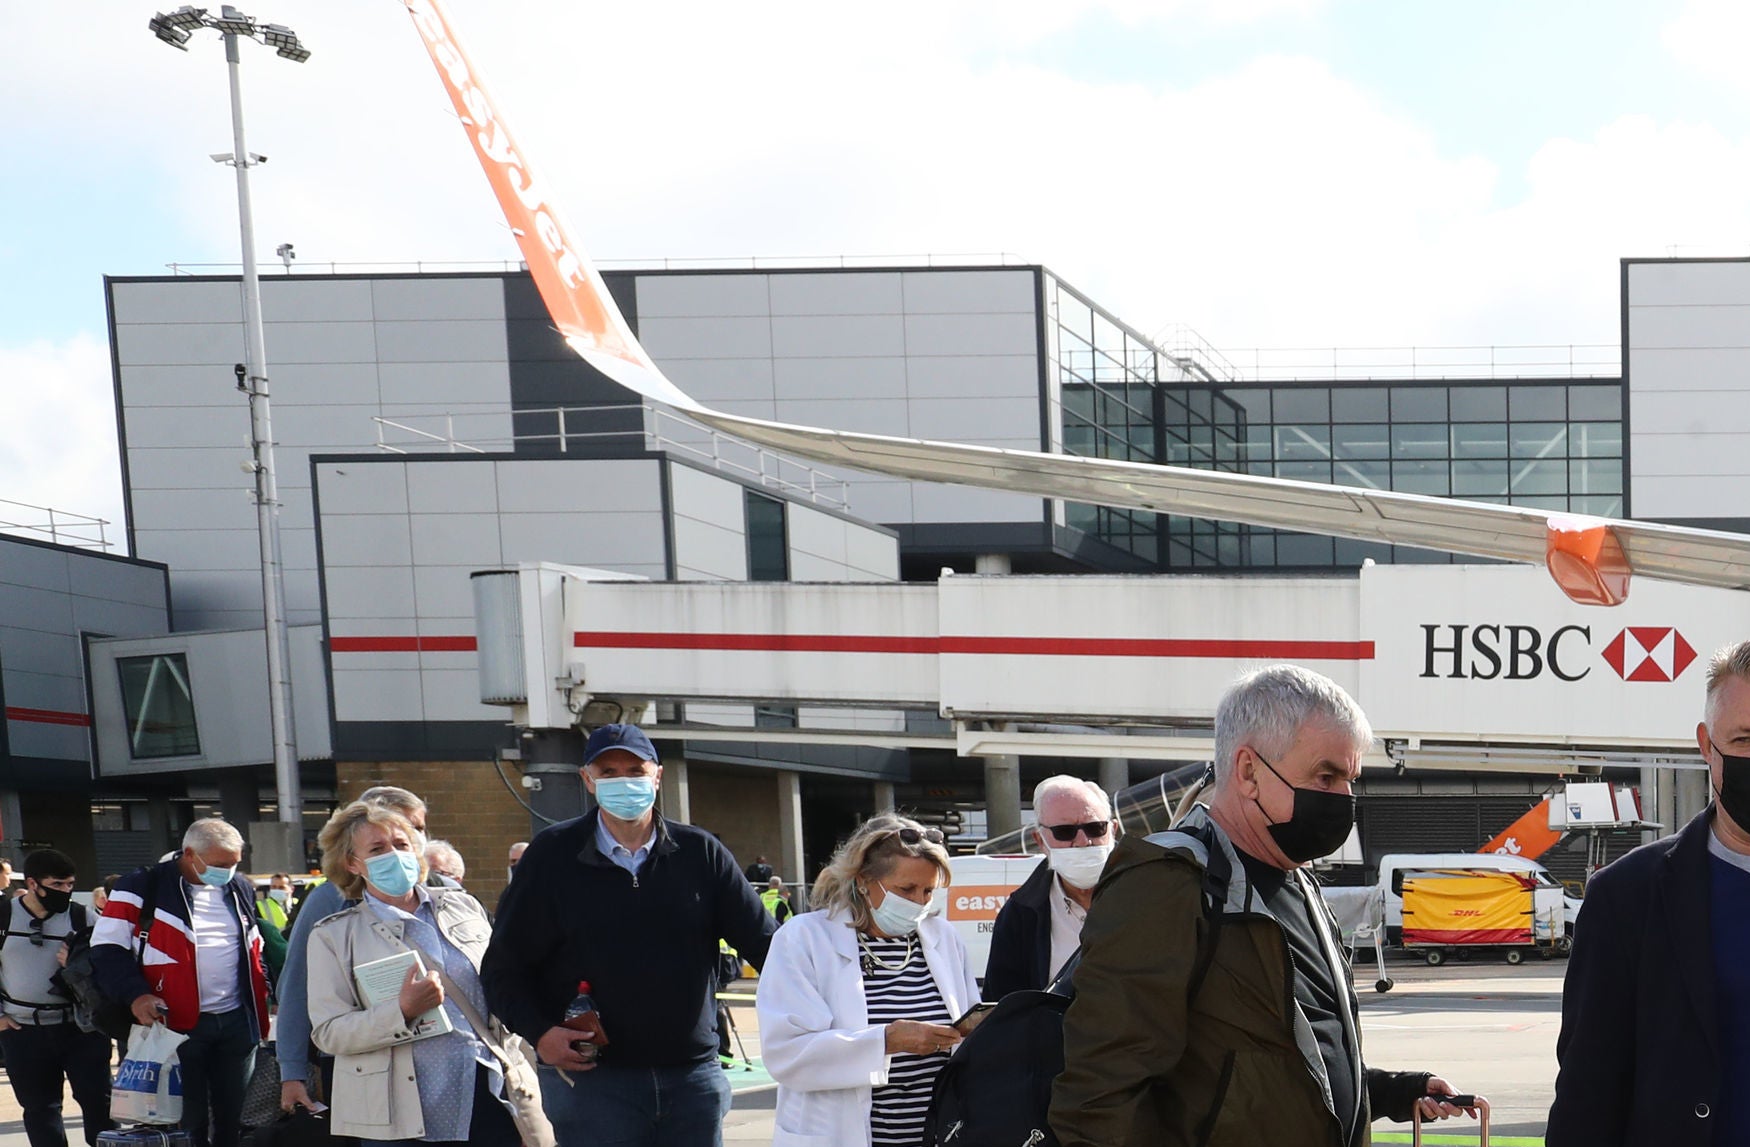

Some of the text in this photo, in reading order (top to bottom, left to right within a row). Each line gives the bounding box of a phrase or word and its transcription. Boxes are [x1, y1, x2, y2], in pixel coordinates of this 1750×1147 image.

[1419, 624, 1591, 682] HSBC
[956, 895, 1011, 914] easy
[1453, 909, 1481, 917] DHL
[977, 922, 995, 933] ENG
